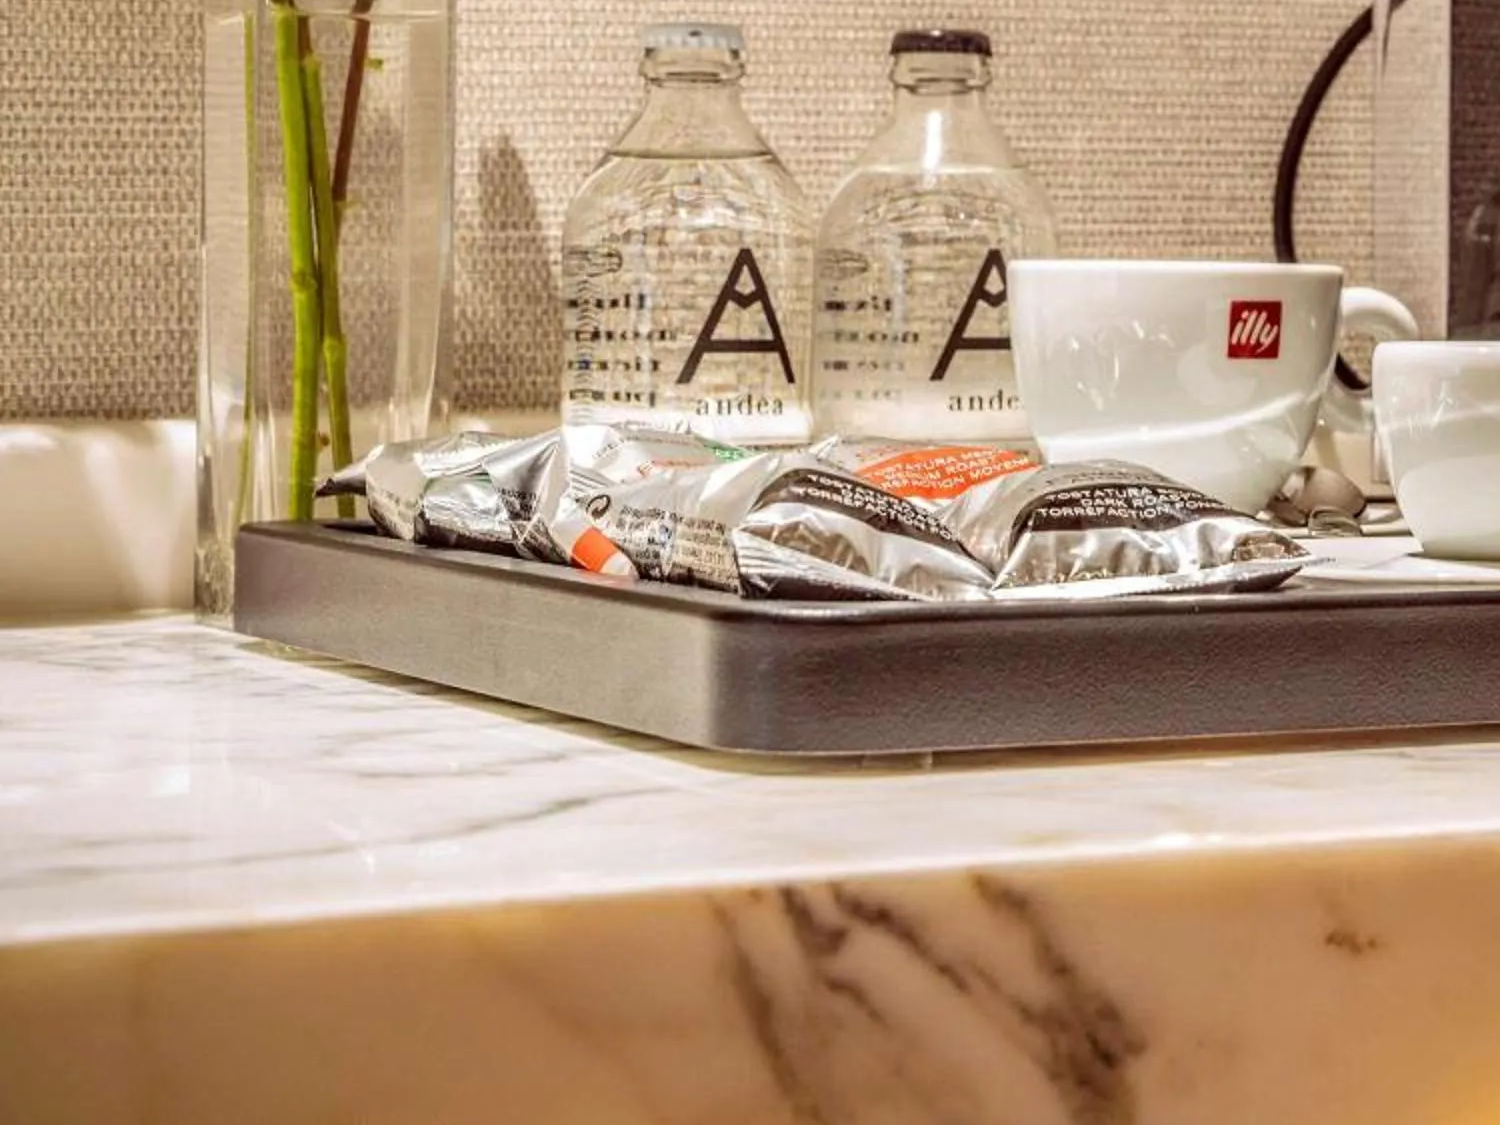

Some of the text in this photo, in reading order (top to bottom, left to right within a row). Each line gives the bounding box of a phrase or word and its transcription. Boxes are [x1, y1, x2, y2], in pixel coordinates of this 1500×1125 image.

[675, 248, 796, 384] A
[929, 248, 1013, 381] A
[1230, 309, 1279, 356] illy
[695, 394, 784, 416] andea
[948, 389, 1023, 412] ande
[1080, 496, 1129, 508] DARK
